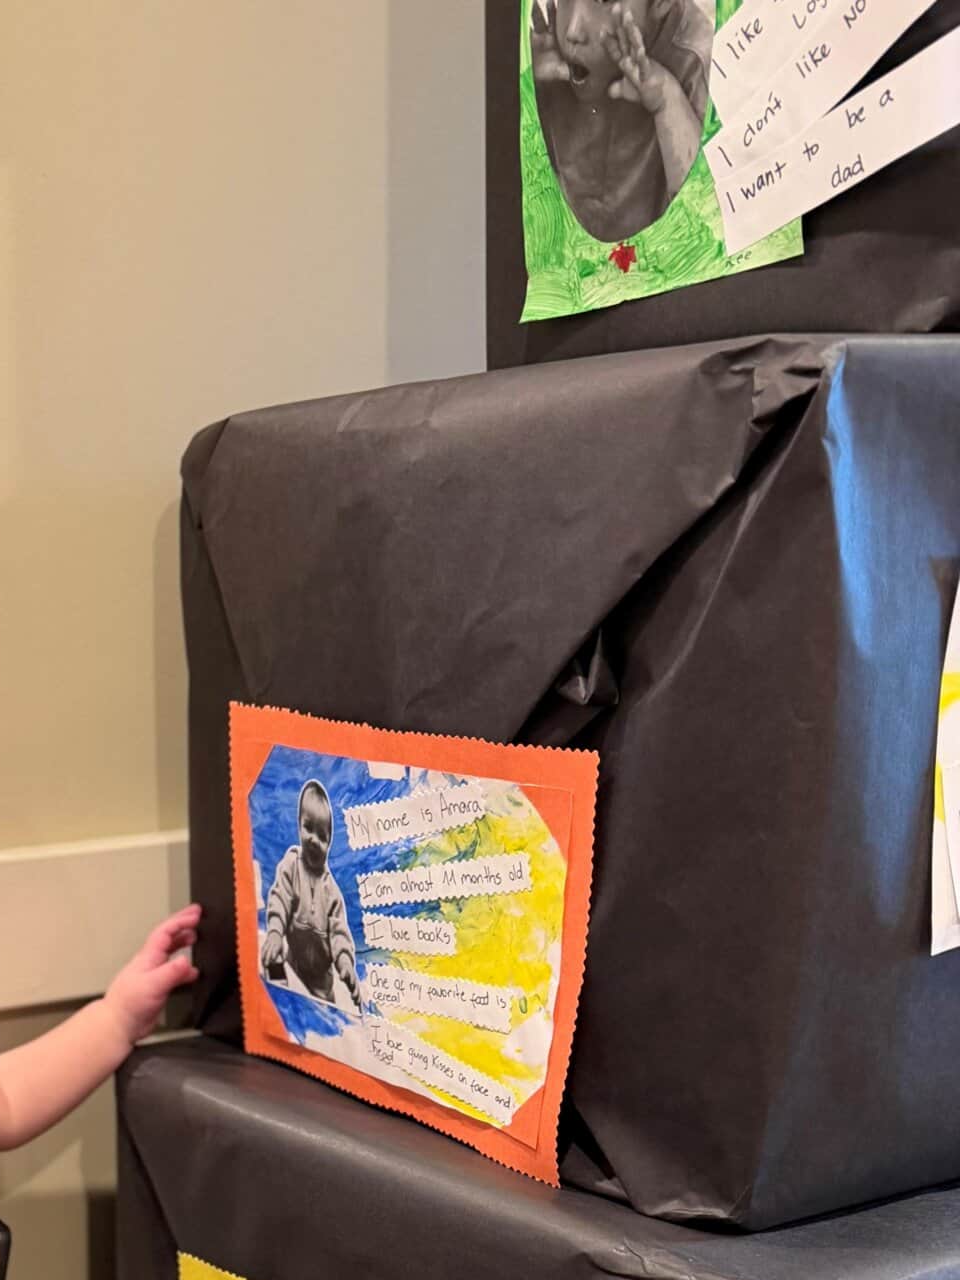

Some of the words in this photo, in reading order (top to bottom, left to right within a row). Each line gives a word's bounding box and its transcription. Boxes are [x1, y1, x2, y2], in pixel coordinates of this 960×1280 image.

[726, 18, 764, 60] like
[718, 146, 733, 167] I
[795, 43, 832, 79] like
[741, 161, 788, 200] want
[803, 141, 820, 162] to
[846, 106, 866, 128] be
[879, 88, 895, 108] a
[830, 154, 865, 188] dad
[350, 815, 371, 843] My
[376, 812, 410, 831] name
[440, 793, 482, 819] Amara
[360, 876, 372, 899] I
[375, 883, 392, 898] am
[400, 871, 434, 893] almost
[460, 866, 502, 886] months
[509, 862, 524, 881] old
[366, 919, 384, 941] I
[390, 920, 410, 941] love
[416, 920, 451, 944] books
[370, 970, 389, 990] One
[394, 979, 406, 996] of
[409, 982, 422, 1001] my
[427, 984, 467, 1002] favorite
[469, 991, 489, 1008] food
[373, 992, 400, 1004] cereal
[470, 1079, 489, 1097] face
[494, 1095, 511, 1108] and
